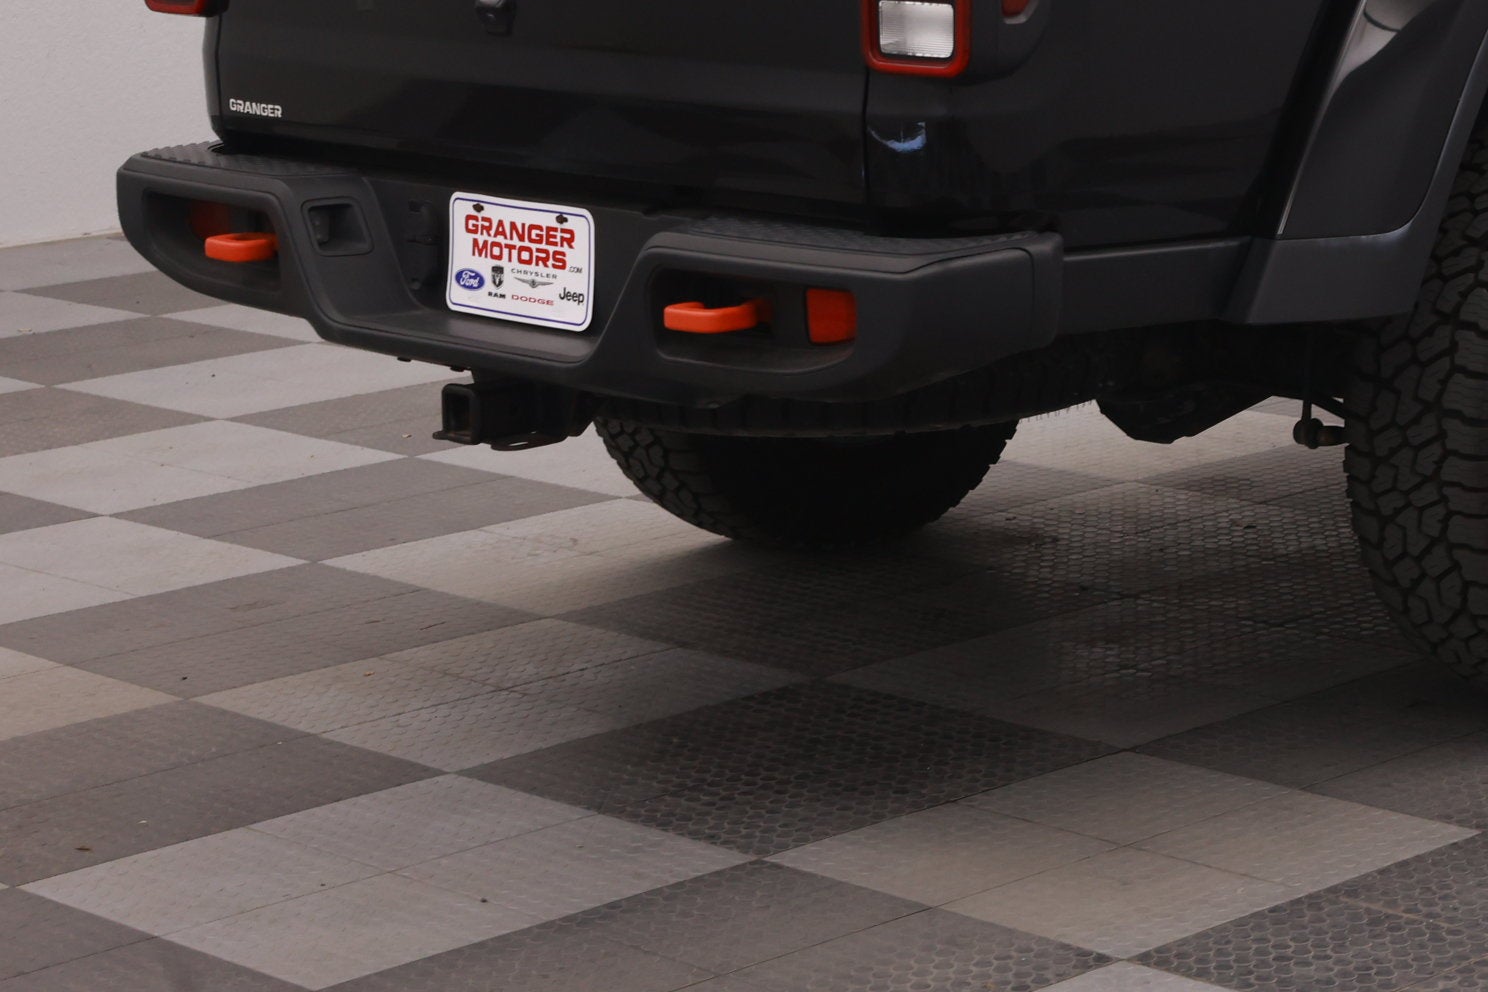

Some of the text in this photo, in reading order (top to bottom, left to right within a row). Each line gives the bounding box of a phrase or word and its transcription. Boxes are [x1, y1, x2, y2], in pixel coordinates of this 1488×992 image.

[229, 98, 283, 118] GRANGER
[464, 214, 576, 249] GRANGER
[472, 238, 567, 270] MOTORS
[460, 270, 480, 288] Ford
[511, 268, 558, 280] CHRYSLER
[488, 291, 506, 299] RAM
[511, 294, 555, 306] DODGE
[559, 287, 585, 306] Jeep
